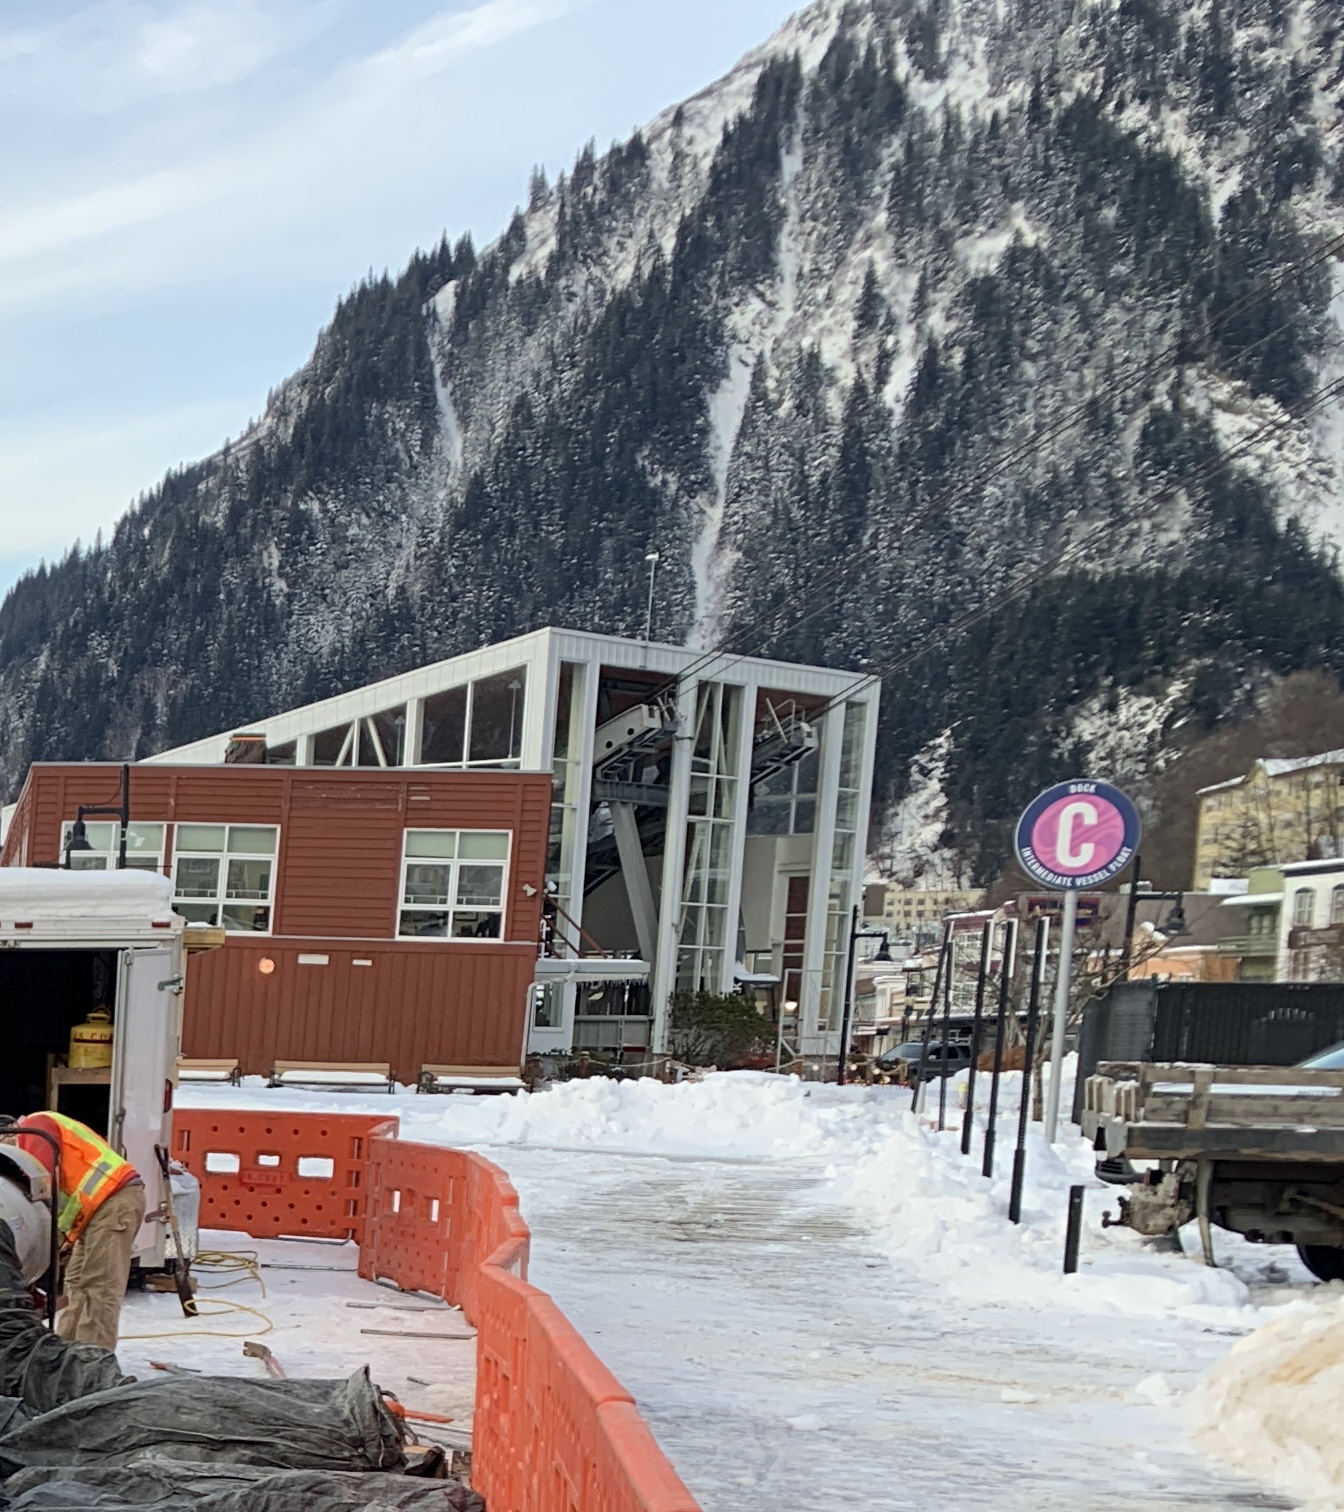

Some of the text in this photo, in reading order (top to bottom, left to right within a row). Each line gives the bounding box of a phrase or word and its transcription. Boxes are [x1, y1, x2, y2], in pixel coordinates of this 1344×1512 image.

[1069, 783, 1098, 794] DOCK
[1057, 802, 1098, 868] C
[1021, 846, 1133, 887] INTERMEDIATE VESSEL FLOAT
